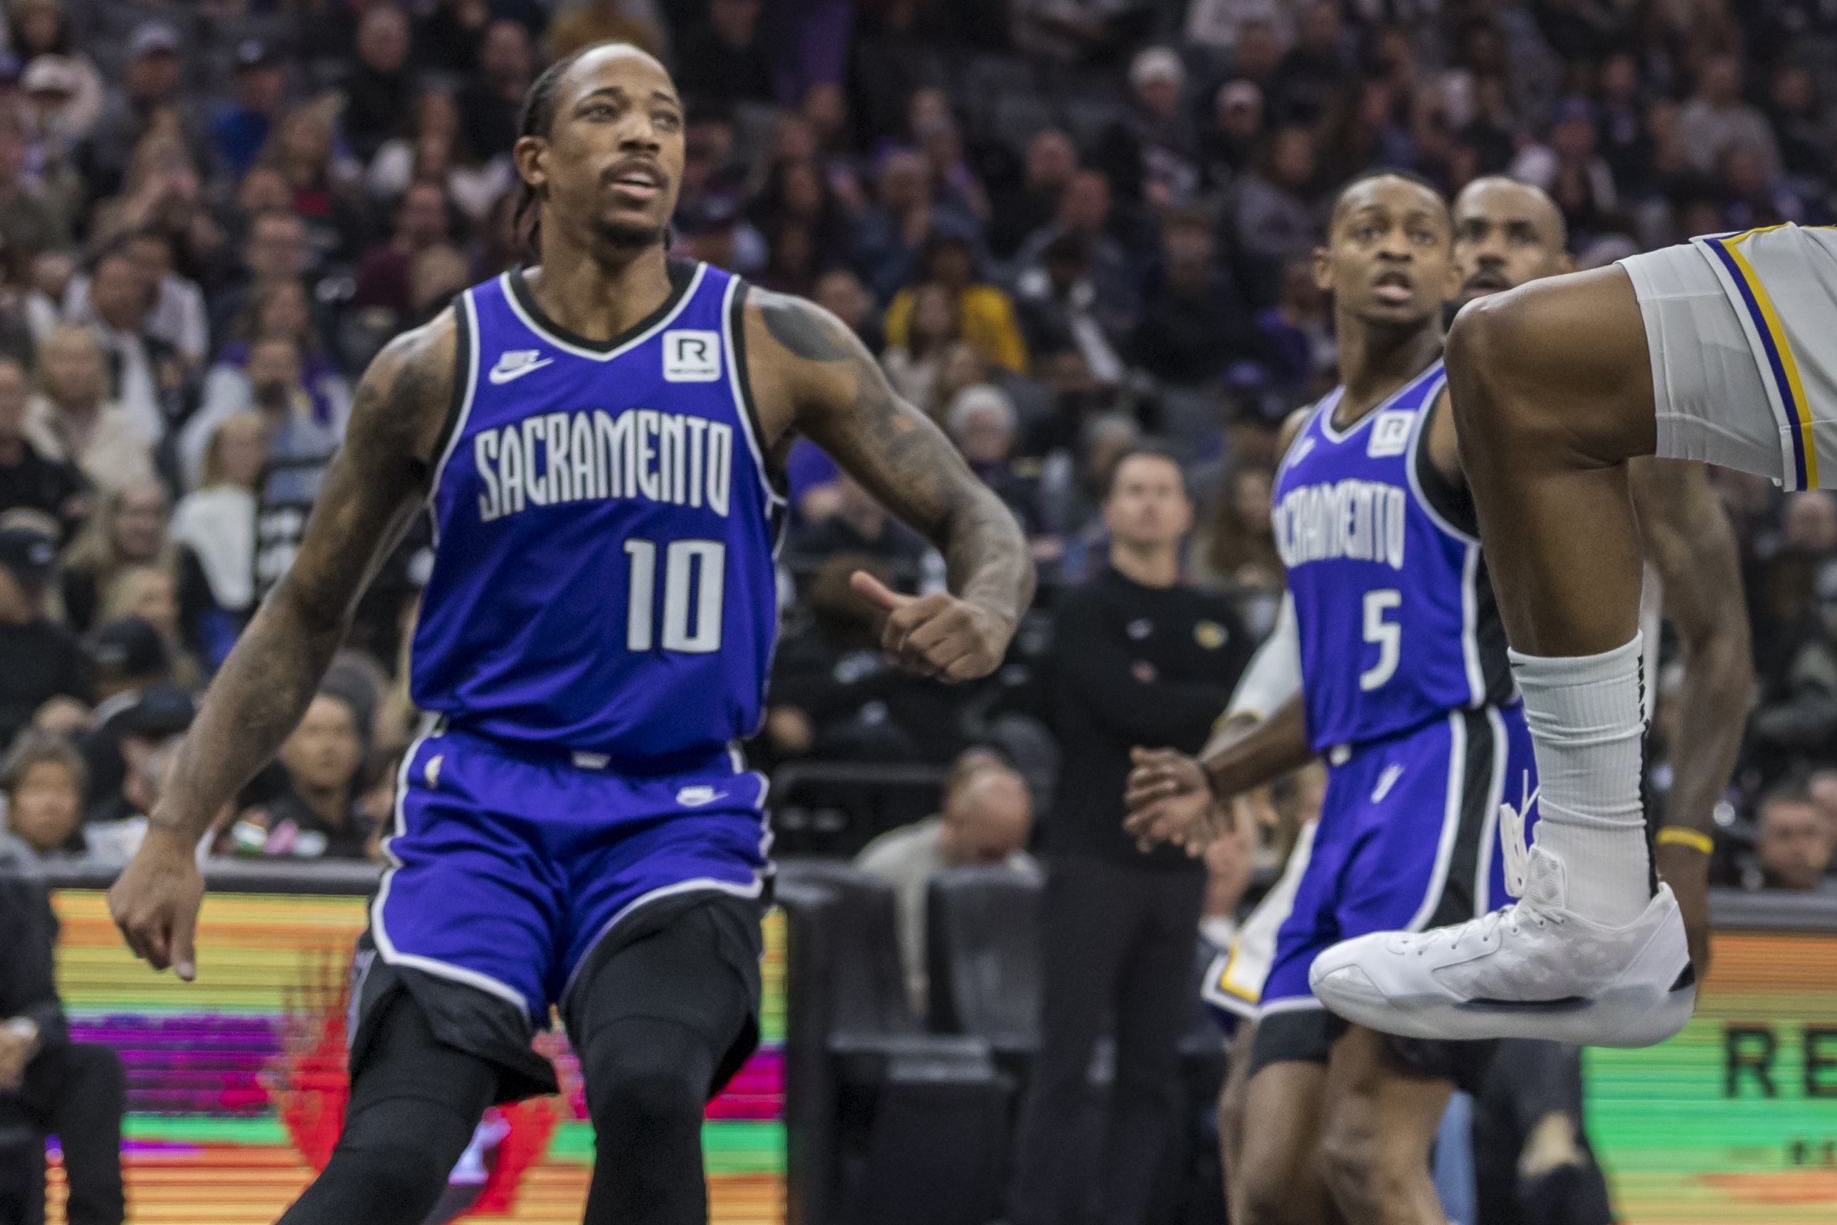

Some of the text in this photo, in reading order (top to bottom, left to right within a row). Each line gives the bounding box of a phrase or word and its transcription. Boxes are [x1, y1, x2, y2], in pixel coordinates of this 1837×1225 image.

[472, 407, 734, 524] SACRAMENTO
[623, 537, 727, 655] 10
[1358, 588, 1402, 692] 5
